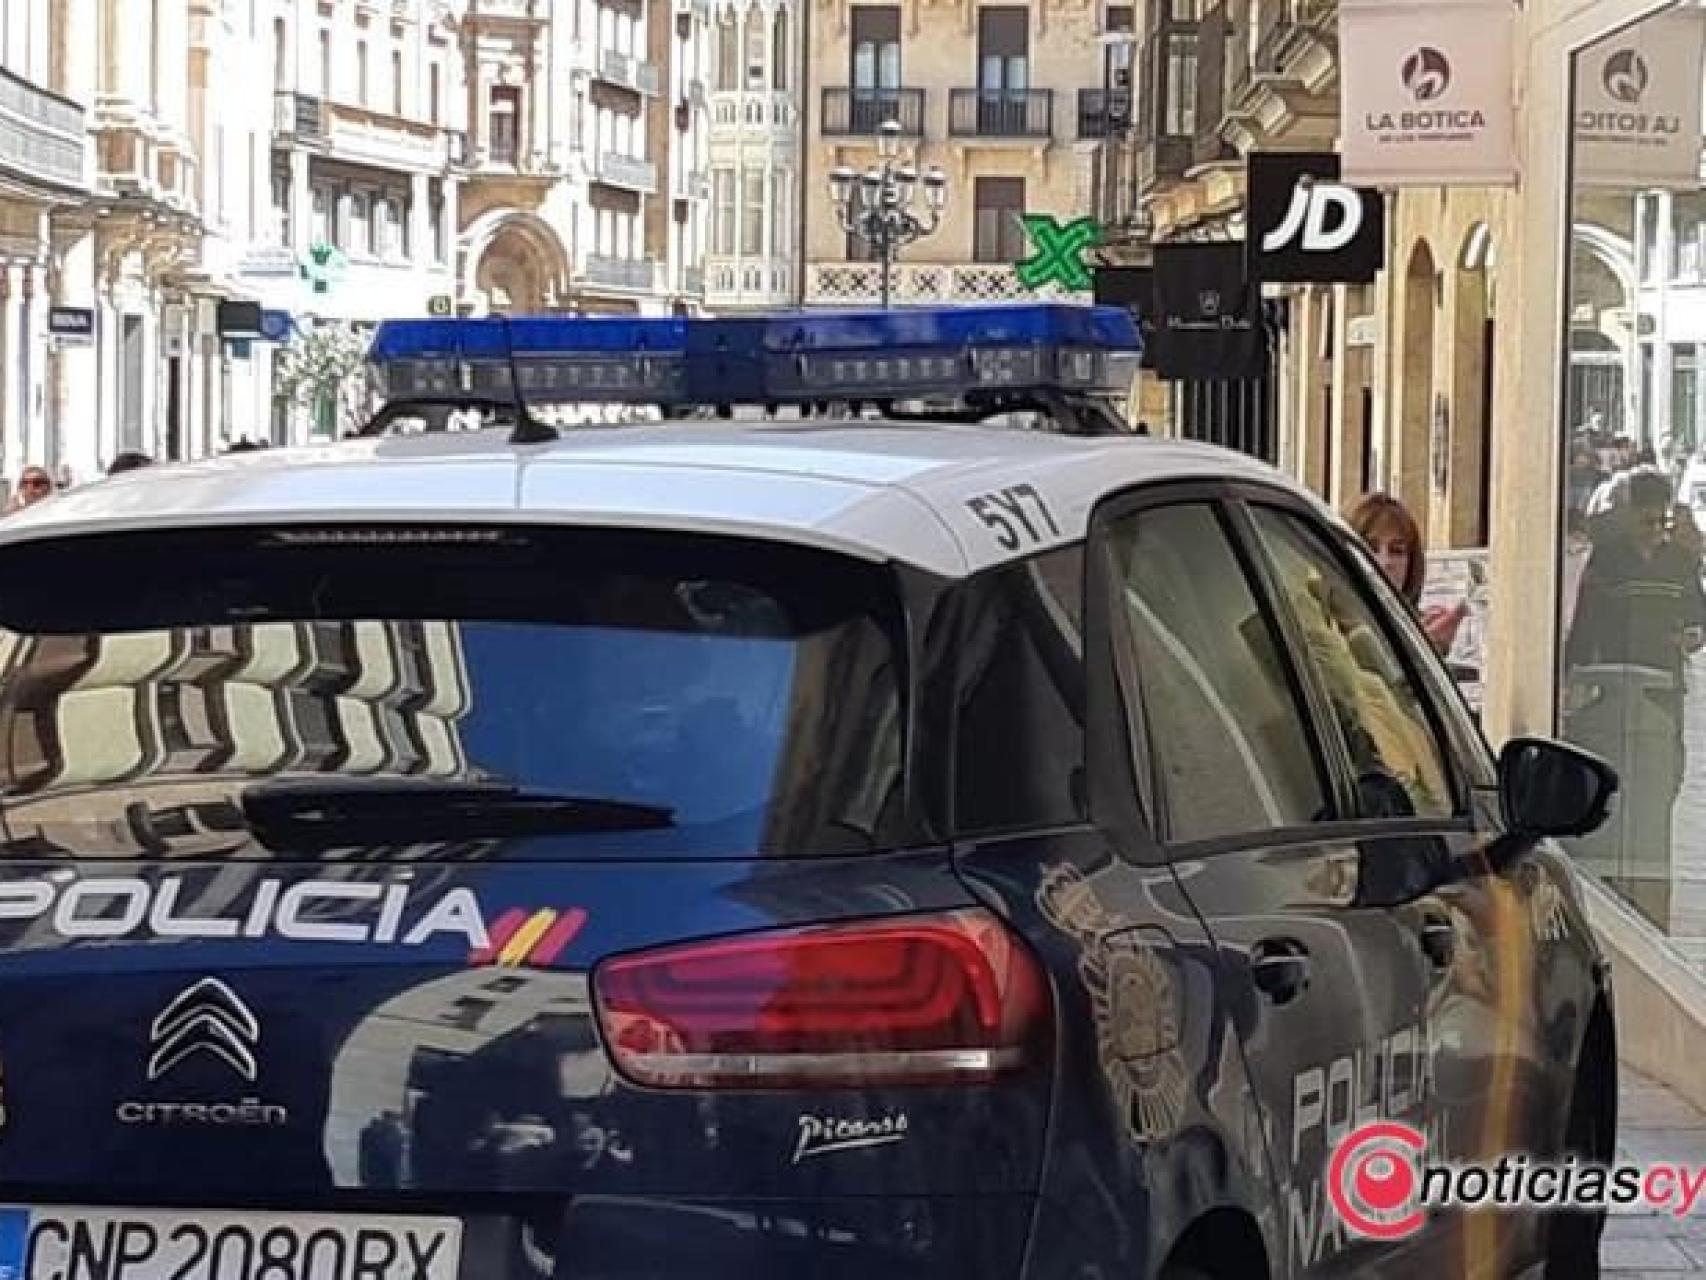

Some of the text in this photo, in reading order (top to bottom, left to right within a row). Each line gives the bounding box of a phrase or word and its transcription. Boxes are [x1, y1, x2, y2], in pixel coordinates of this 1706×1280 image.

[1365, 109, 1486, 131] LA BOTICA
[1261, 174, 1363, 251] JD
[964, 483, 1060, 551] 5Y7
